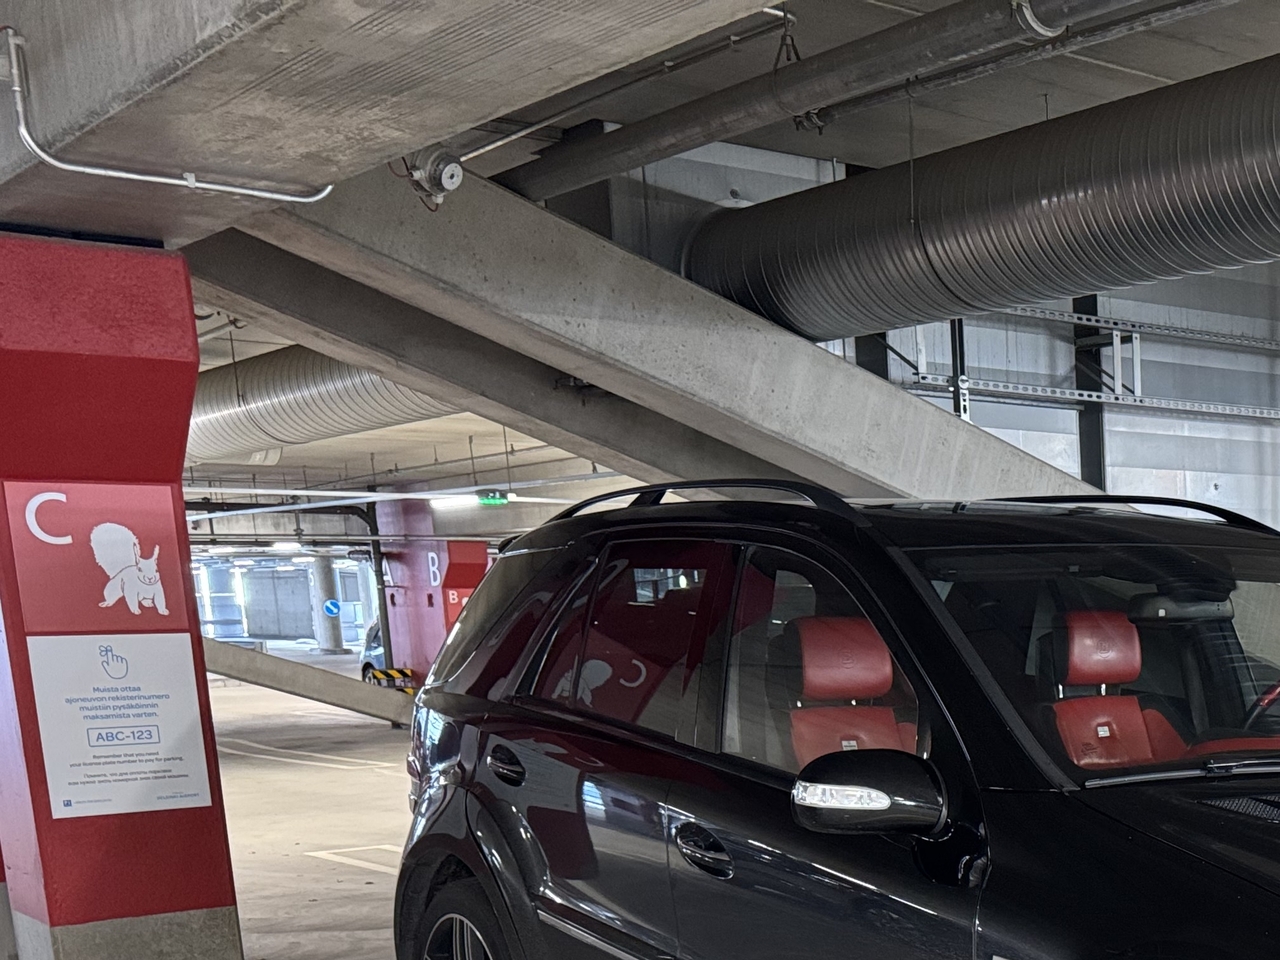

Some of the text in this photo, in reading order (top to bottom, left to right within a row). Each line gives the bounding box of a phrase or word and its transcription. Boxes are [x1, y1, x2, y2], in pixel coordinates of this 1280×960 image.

[25, 491, 74, 545] C
[427, 551, 441, 587] B
[448, 590, 459, 604] B
[64, 693, 170, 705] ajoneuvon rekisterinumero
[83, 712, 131, 720] maksamista
[95, 729, 153, 742] ABC-123
